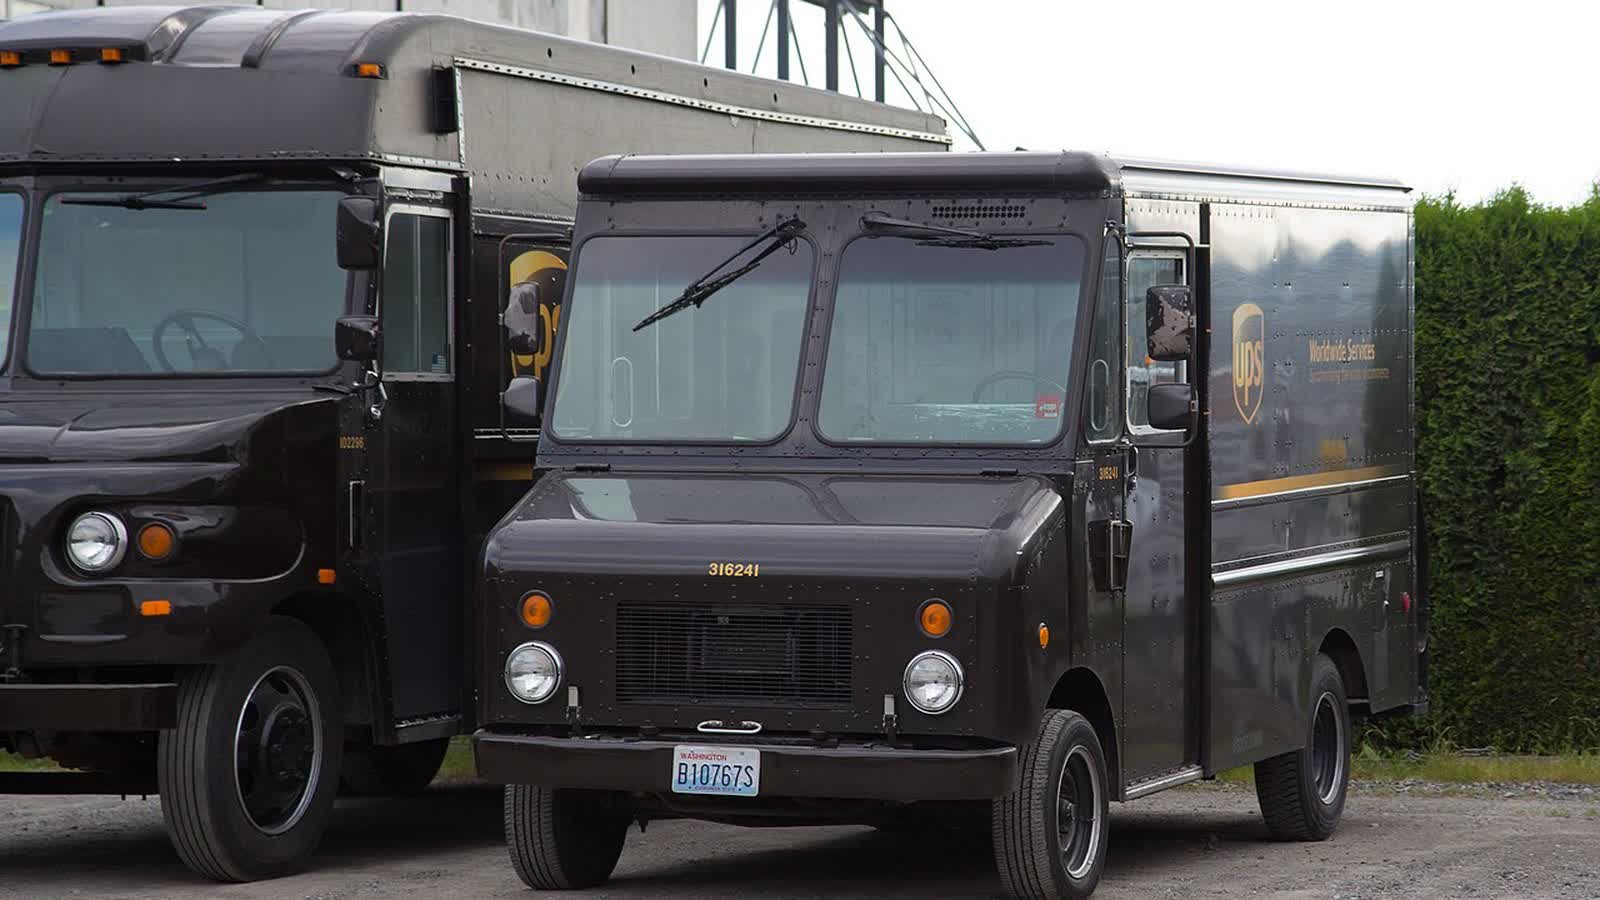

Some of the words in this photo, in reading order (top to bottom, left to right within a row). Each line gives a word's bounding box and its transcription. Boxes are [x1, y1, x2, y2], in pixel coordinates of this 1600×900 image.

[1309, 338, 1346, 363] Worldwide
[1347, 338, 1376, 361] Services
[708, 562, 759, 577] 316241
[680, 752, 727, 761] WASHINGTON
[678, 762, 754, 788] B10767S
